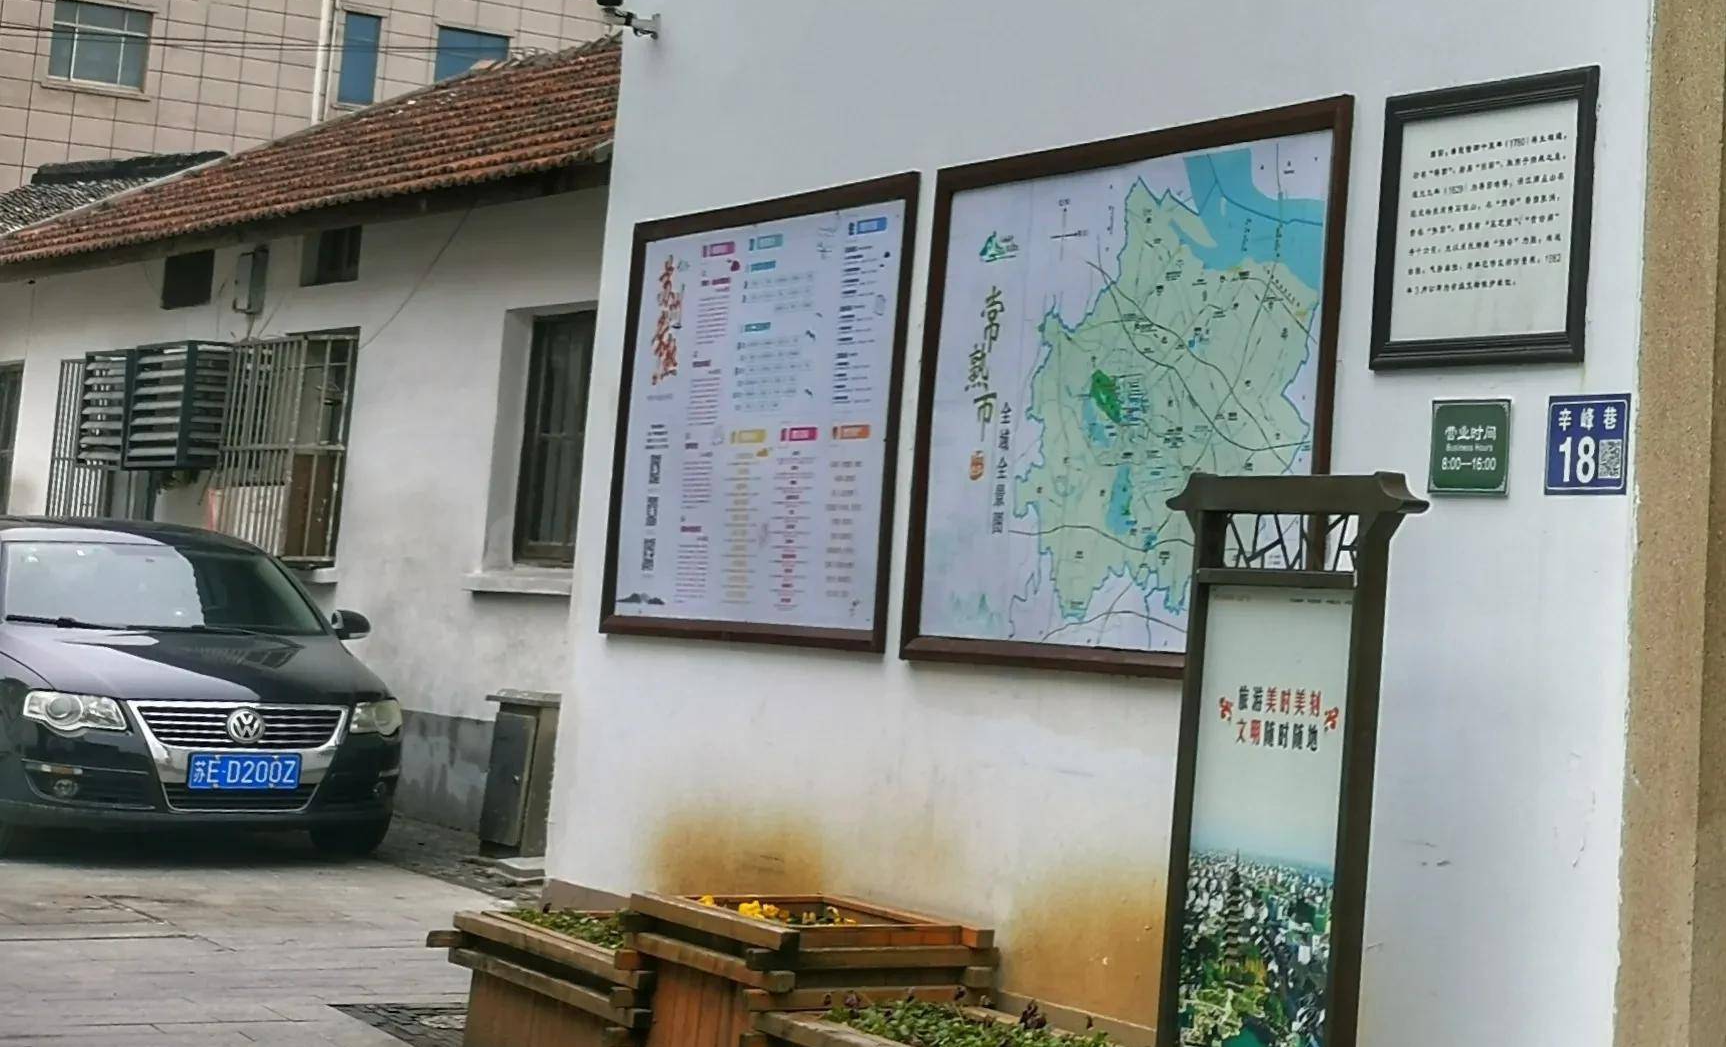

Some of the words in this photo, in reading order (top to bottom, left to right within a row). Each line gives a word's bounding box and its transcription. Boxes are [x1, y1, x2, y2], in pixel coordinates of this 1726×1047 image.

[1444, 425, 1497, 441] 营业时间
[1558, 407, 1617, 431] 辛峰巷
[1446, 442, 1474, 452] Business
[1474, 442, 1494, 452] Hours
[1559, 436, 1596, 483] 18
[1238, 685, 1321, 717] 旅游美时美刻
[1235, 718, 1319, 752] 文明随时随地
